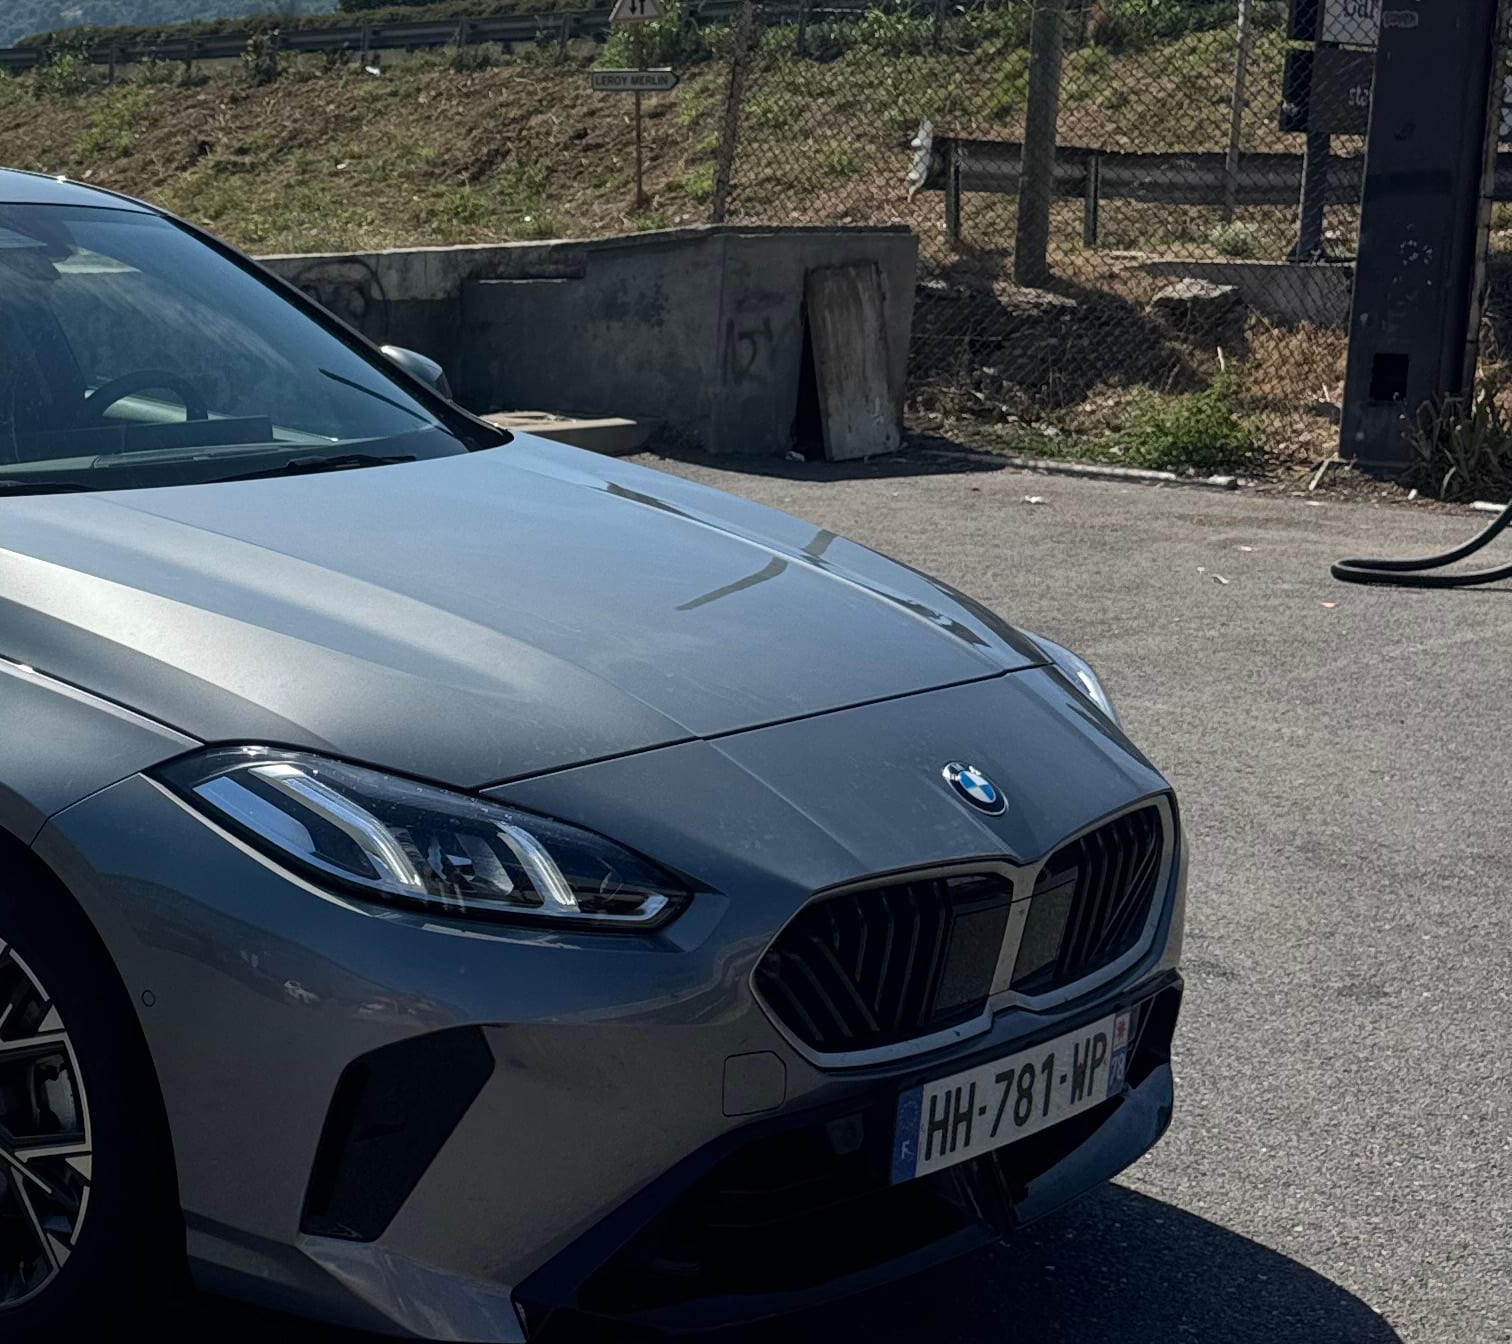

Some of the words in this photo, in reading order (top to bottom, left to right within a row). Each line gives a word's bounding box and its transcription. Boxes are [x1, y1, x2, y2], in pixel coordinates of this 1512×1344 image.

[595, 75, 628, 86] LEROY
[630, 75, 669, 86] MERLIN
[924, 1031, 1108, 1161] HH-781-WP
[1110, 1053, 1126, 1084] 78
